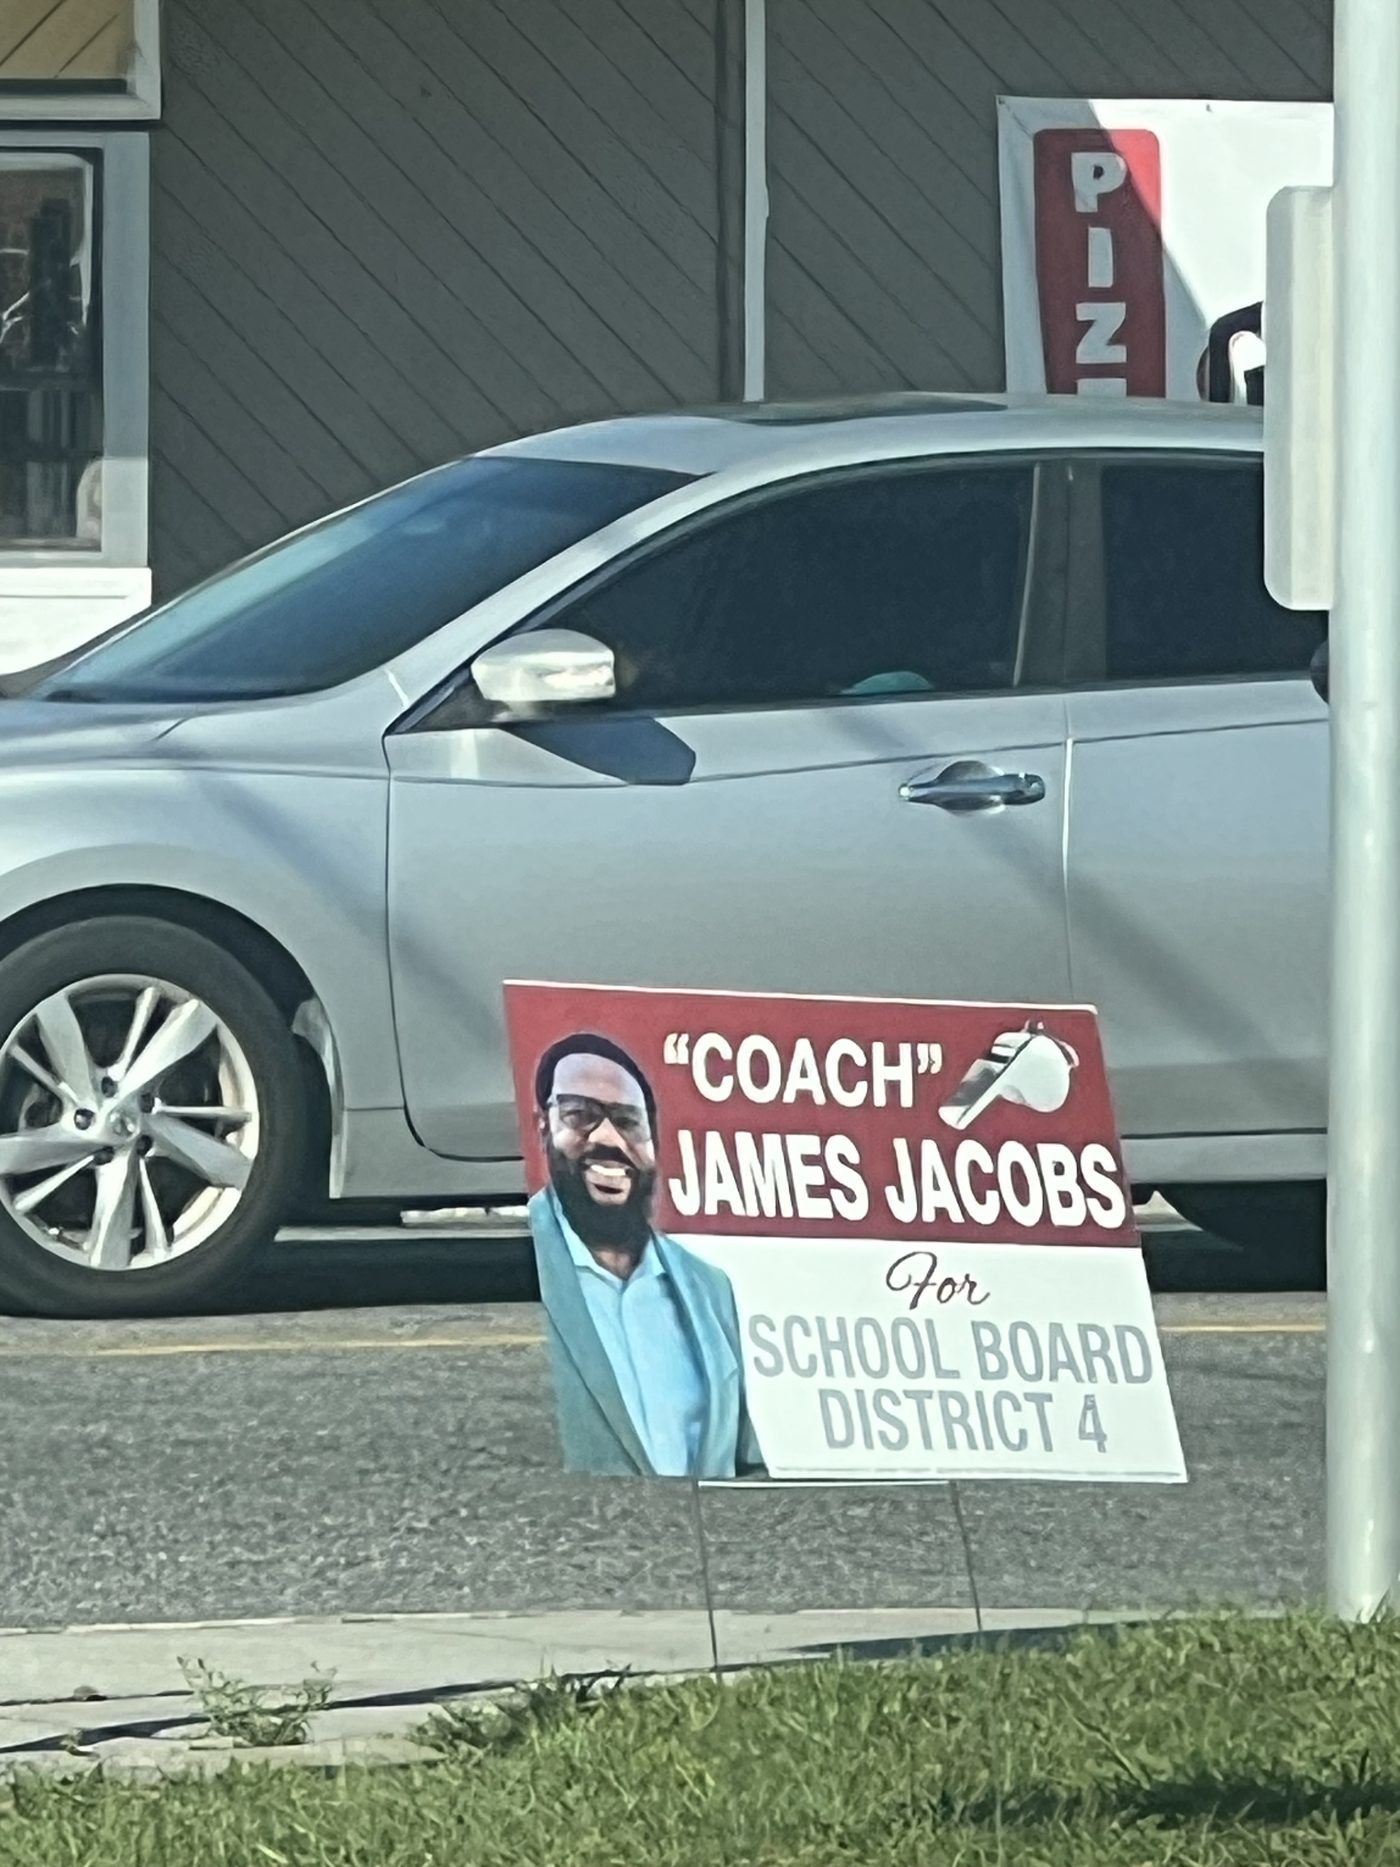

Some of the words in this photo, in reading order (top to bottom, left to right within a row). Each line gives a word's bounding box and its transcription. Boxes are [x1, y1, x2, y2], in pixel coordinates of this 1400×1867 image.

[663, 1031, 943, 1108] “COACH”
[668, 1129, 869, 1221] JAMES
[884, 1137, 1127, 1229] JACOBS
[885, 1251, 991, 1310] For
[747, 1314, 961, 1380] SCHOOL
[970, 1320, 1153, 1385] BOARD
[818, 1388, 1054, 1452] DISTRICT
[1078, 1394, 1107, 1453] 4
